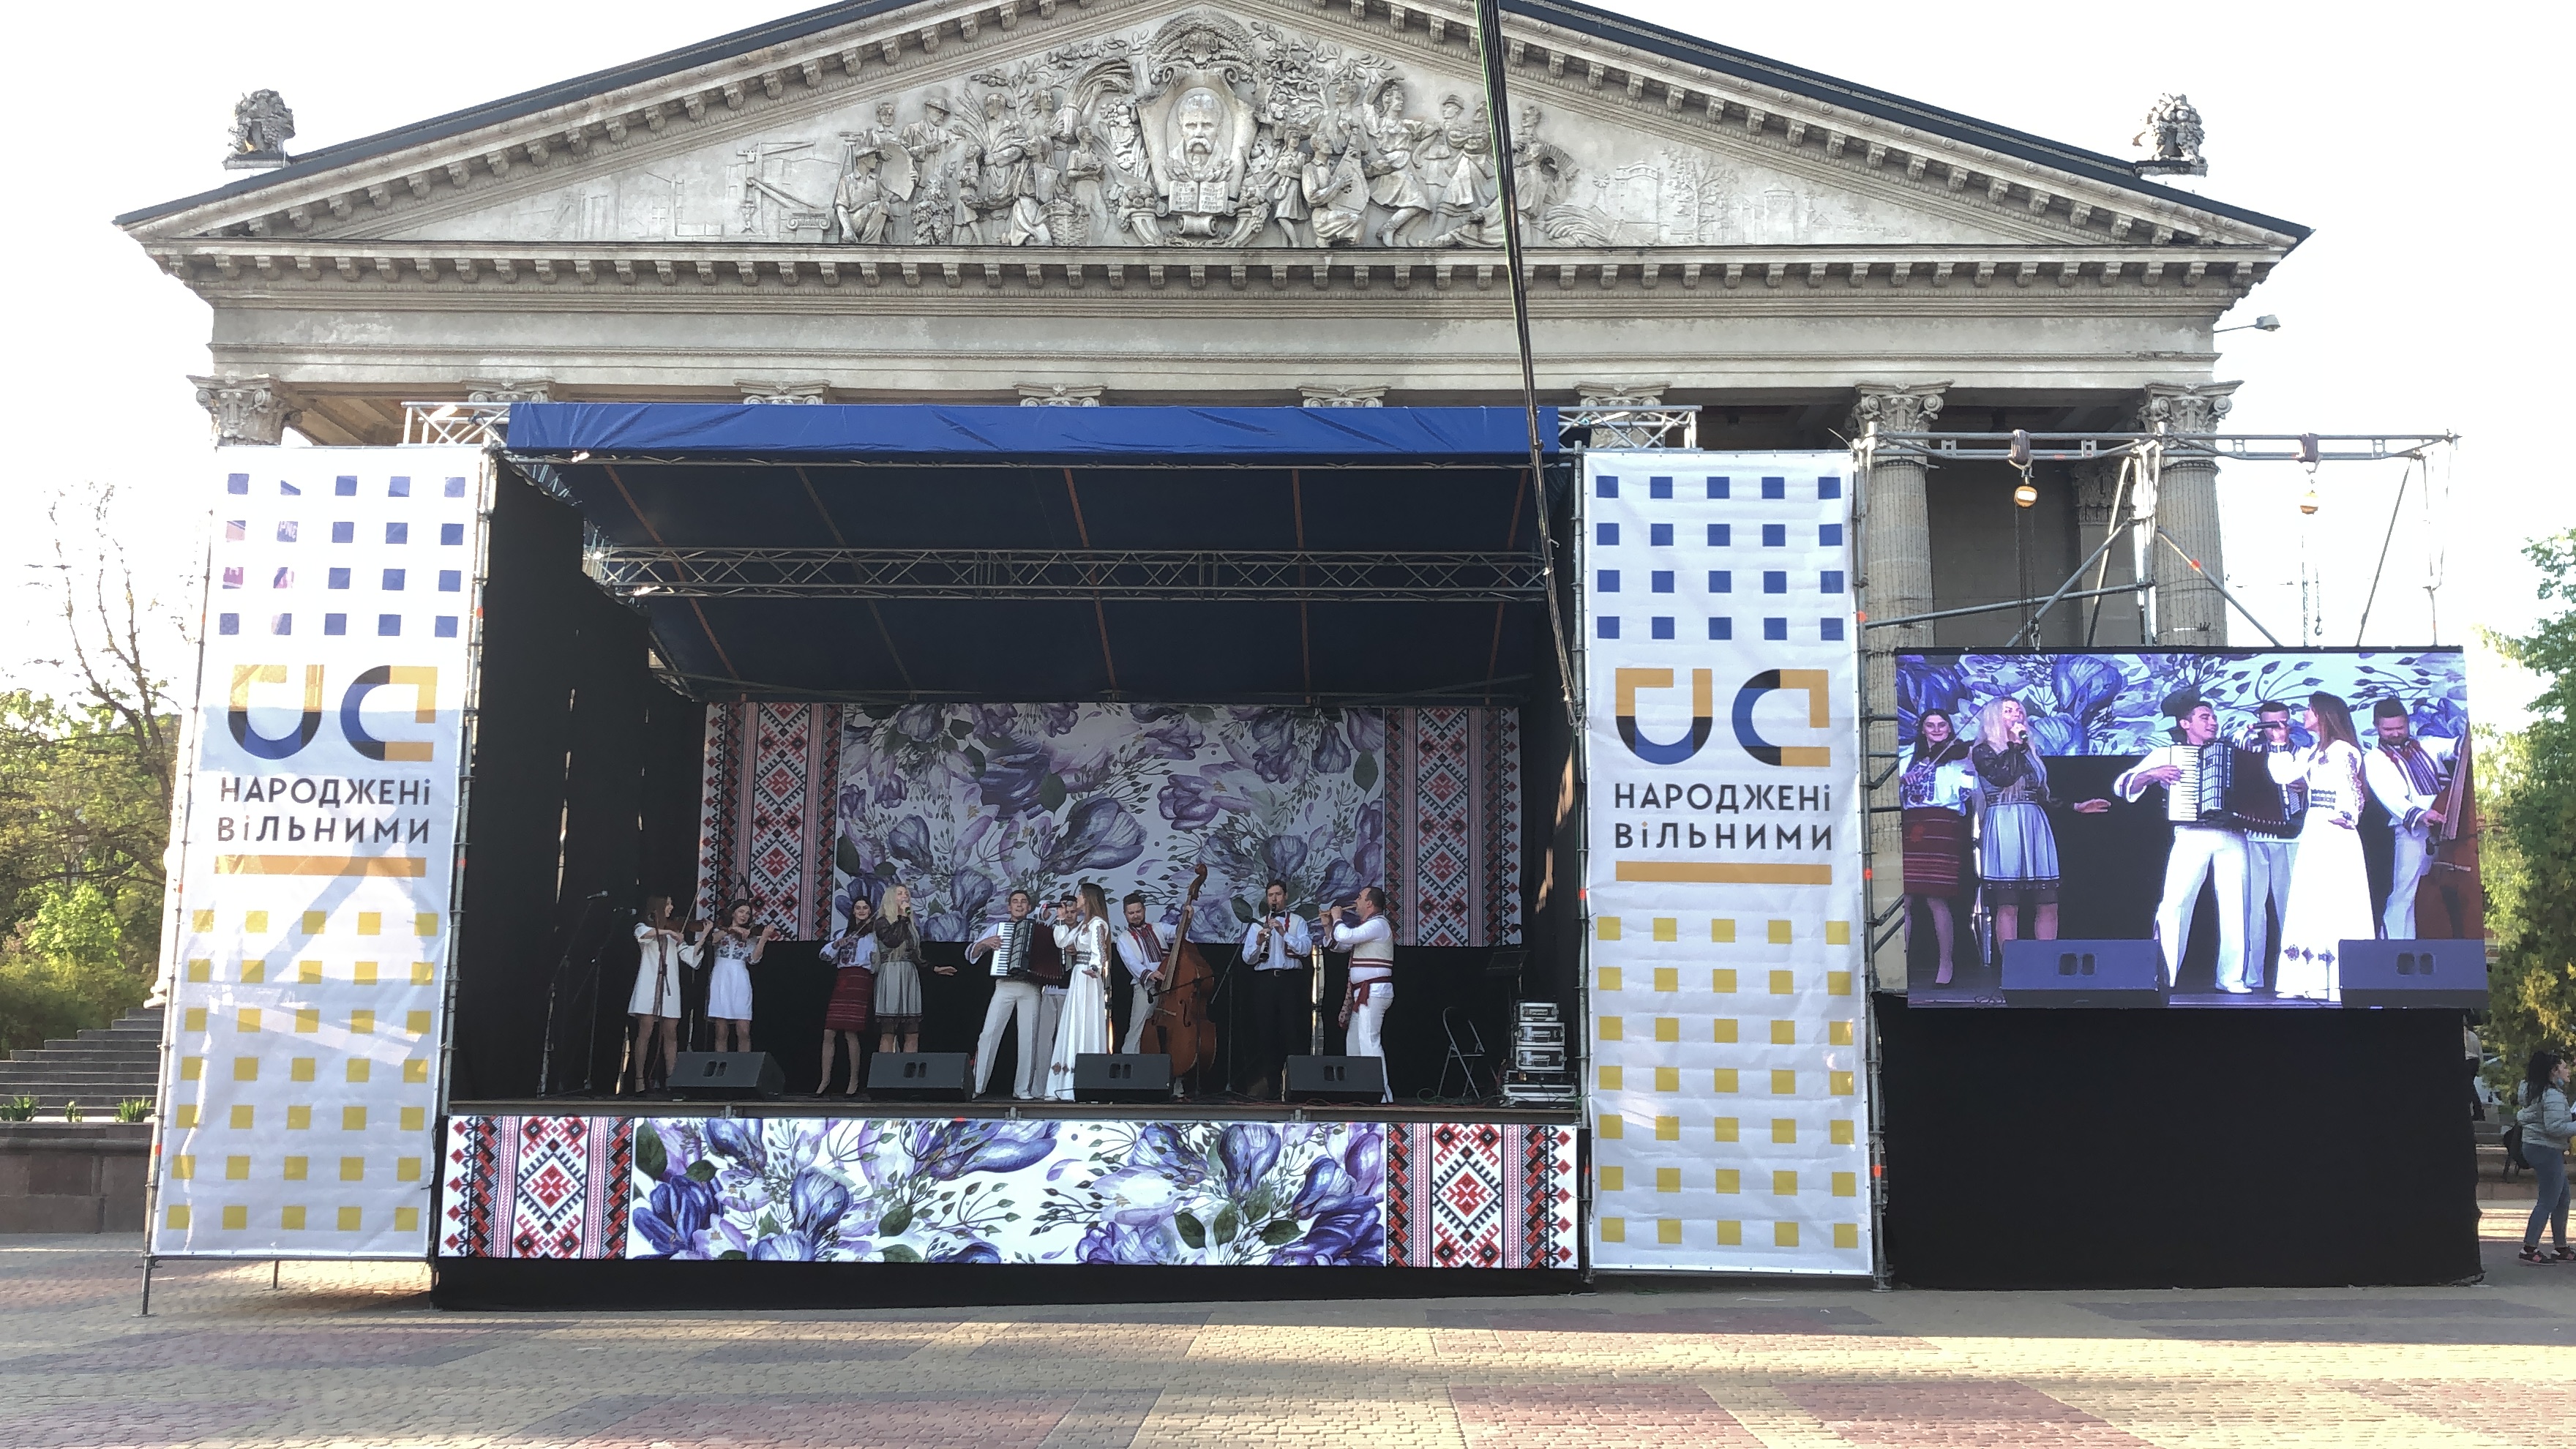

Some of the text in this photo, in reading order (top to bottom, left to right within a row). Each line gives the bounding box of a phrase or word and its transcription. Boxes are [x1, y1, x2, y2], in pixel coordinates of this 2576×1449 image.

[220, 777, 431, 809] НАРОДЖЕНі
[1614, 782, 1831, 815] НАРОДЖЕНі
[217, 815, 430, 845] ВіЛЬНИМИ
[1615, 820, 1832, 851] ВіЛЬНИМИ
